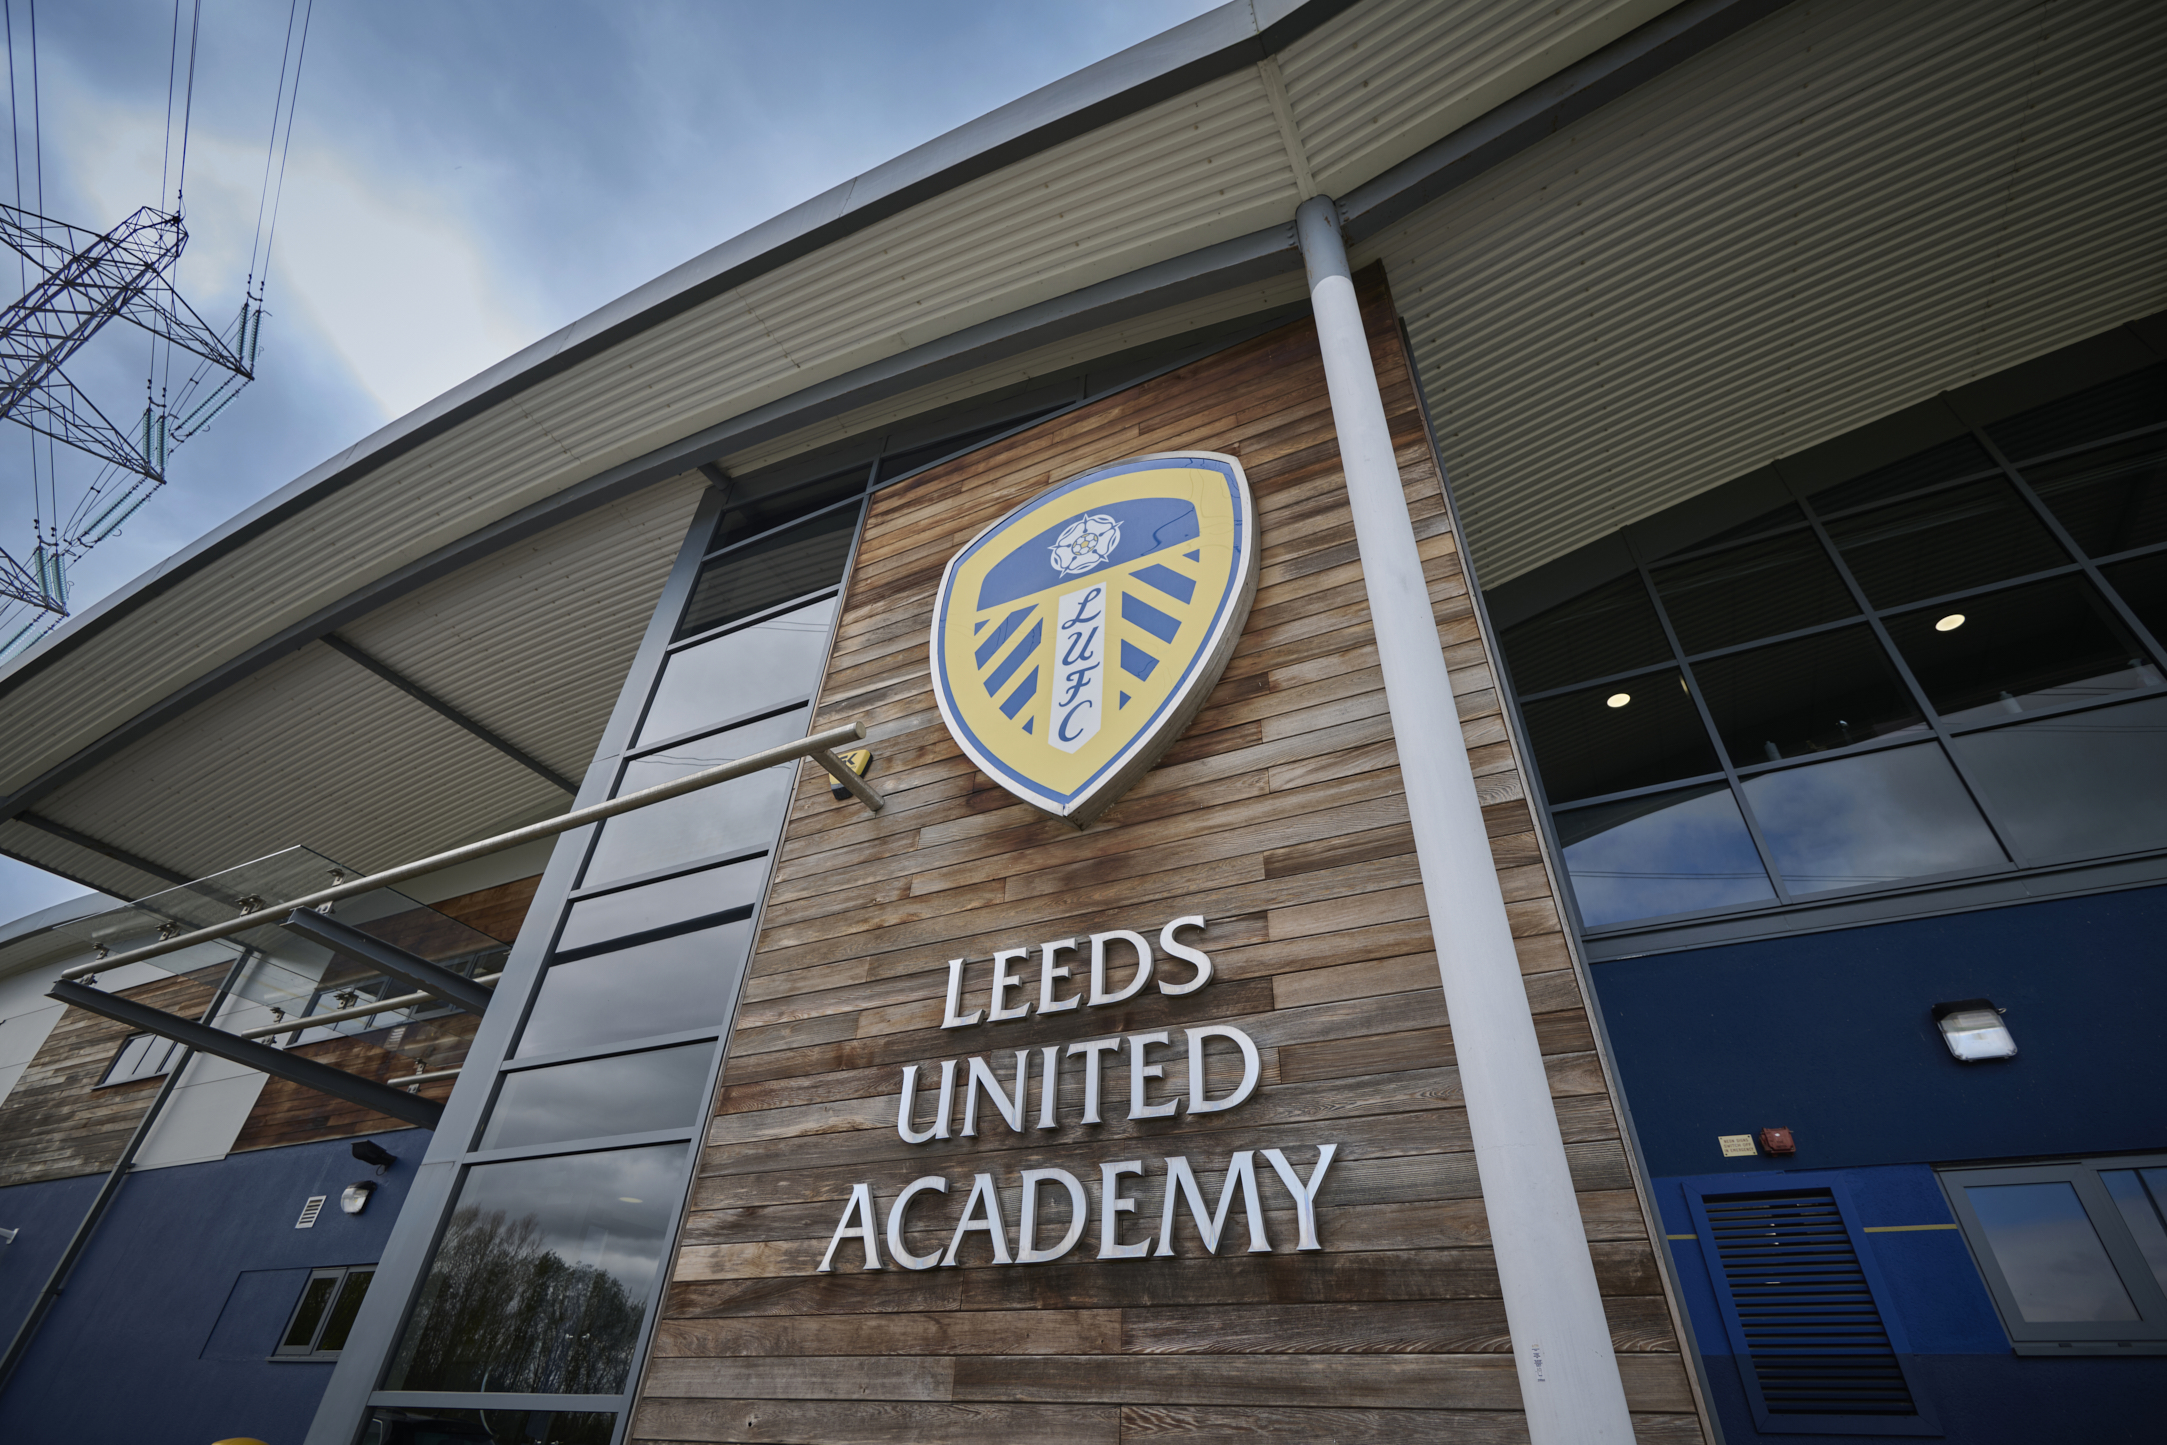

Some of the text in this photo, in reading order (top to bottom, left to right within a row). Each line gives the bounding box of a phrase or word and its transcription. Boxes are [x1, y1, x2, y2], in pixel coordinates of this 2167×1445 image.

[1057, 587, 1102, 743] LUFC
[940, 915, 1215, 1030] LEEDS
[897, 1025, 1262, 1144] UNITED
[816, 1143, 1338, 1273] ACADEMY
